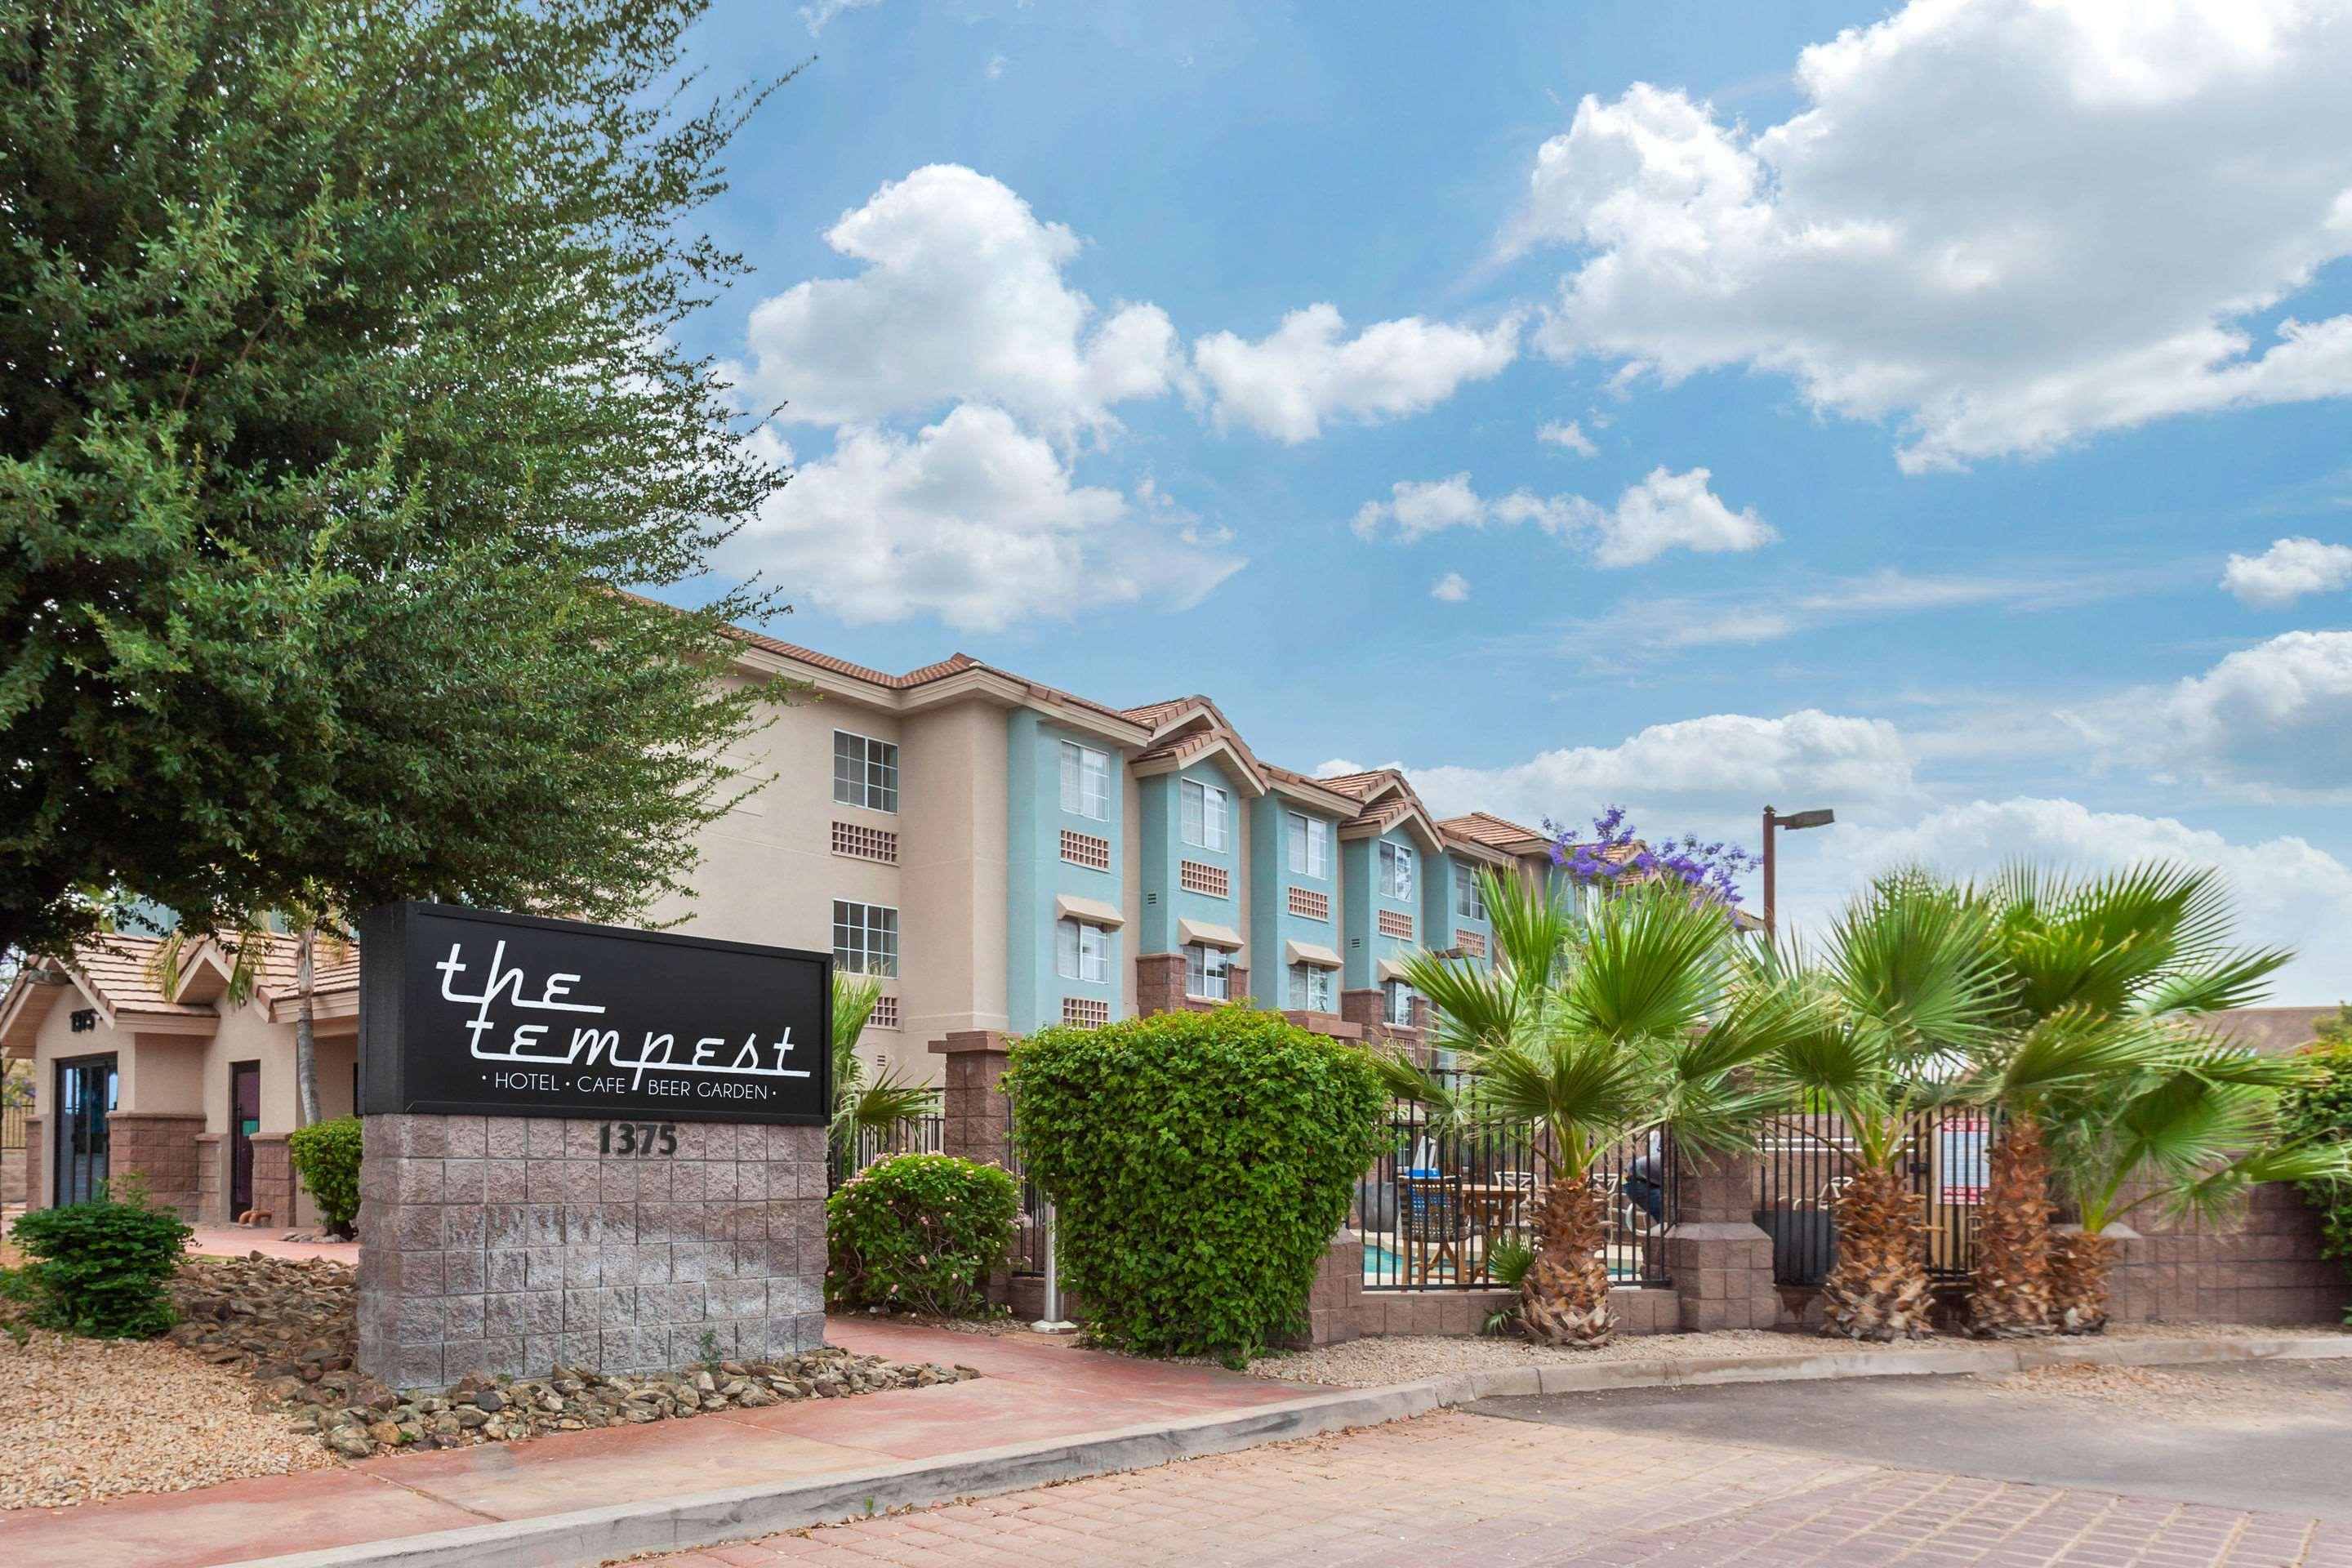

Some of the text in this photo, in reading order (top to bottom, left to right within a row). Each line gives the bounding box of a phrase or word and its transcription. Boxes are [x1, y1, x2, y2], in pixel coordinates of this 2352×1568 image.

[435, 940, 606, 1013] the
[465, 1020, 811, 1090] tempest
[495, 1072, 768, 1100] HOTEL CAFE BEER GARDEN
[600, 1123, 678, 1155] 1375
